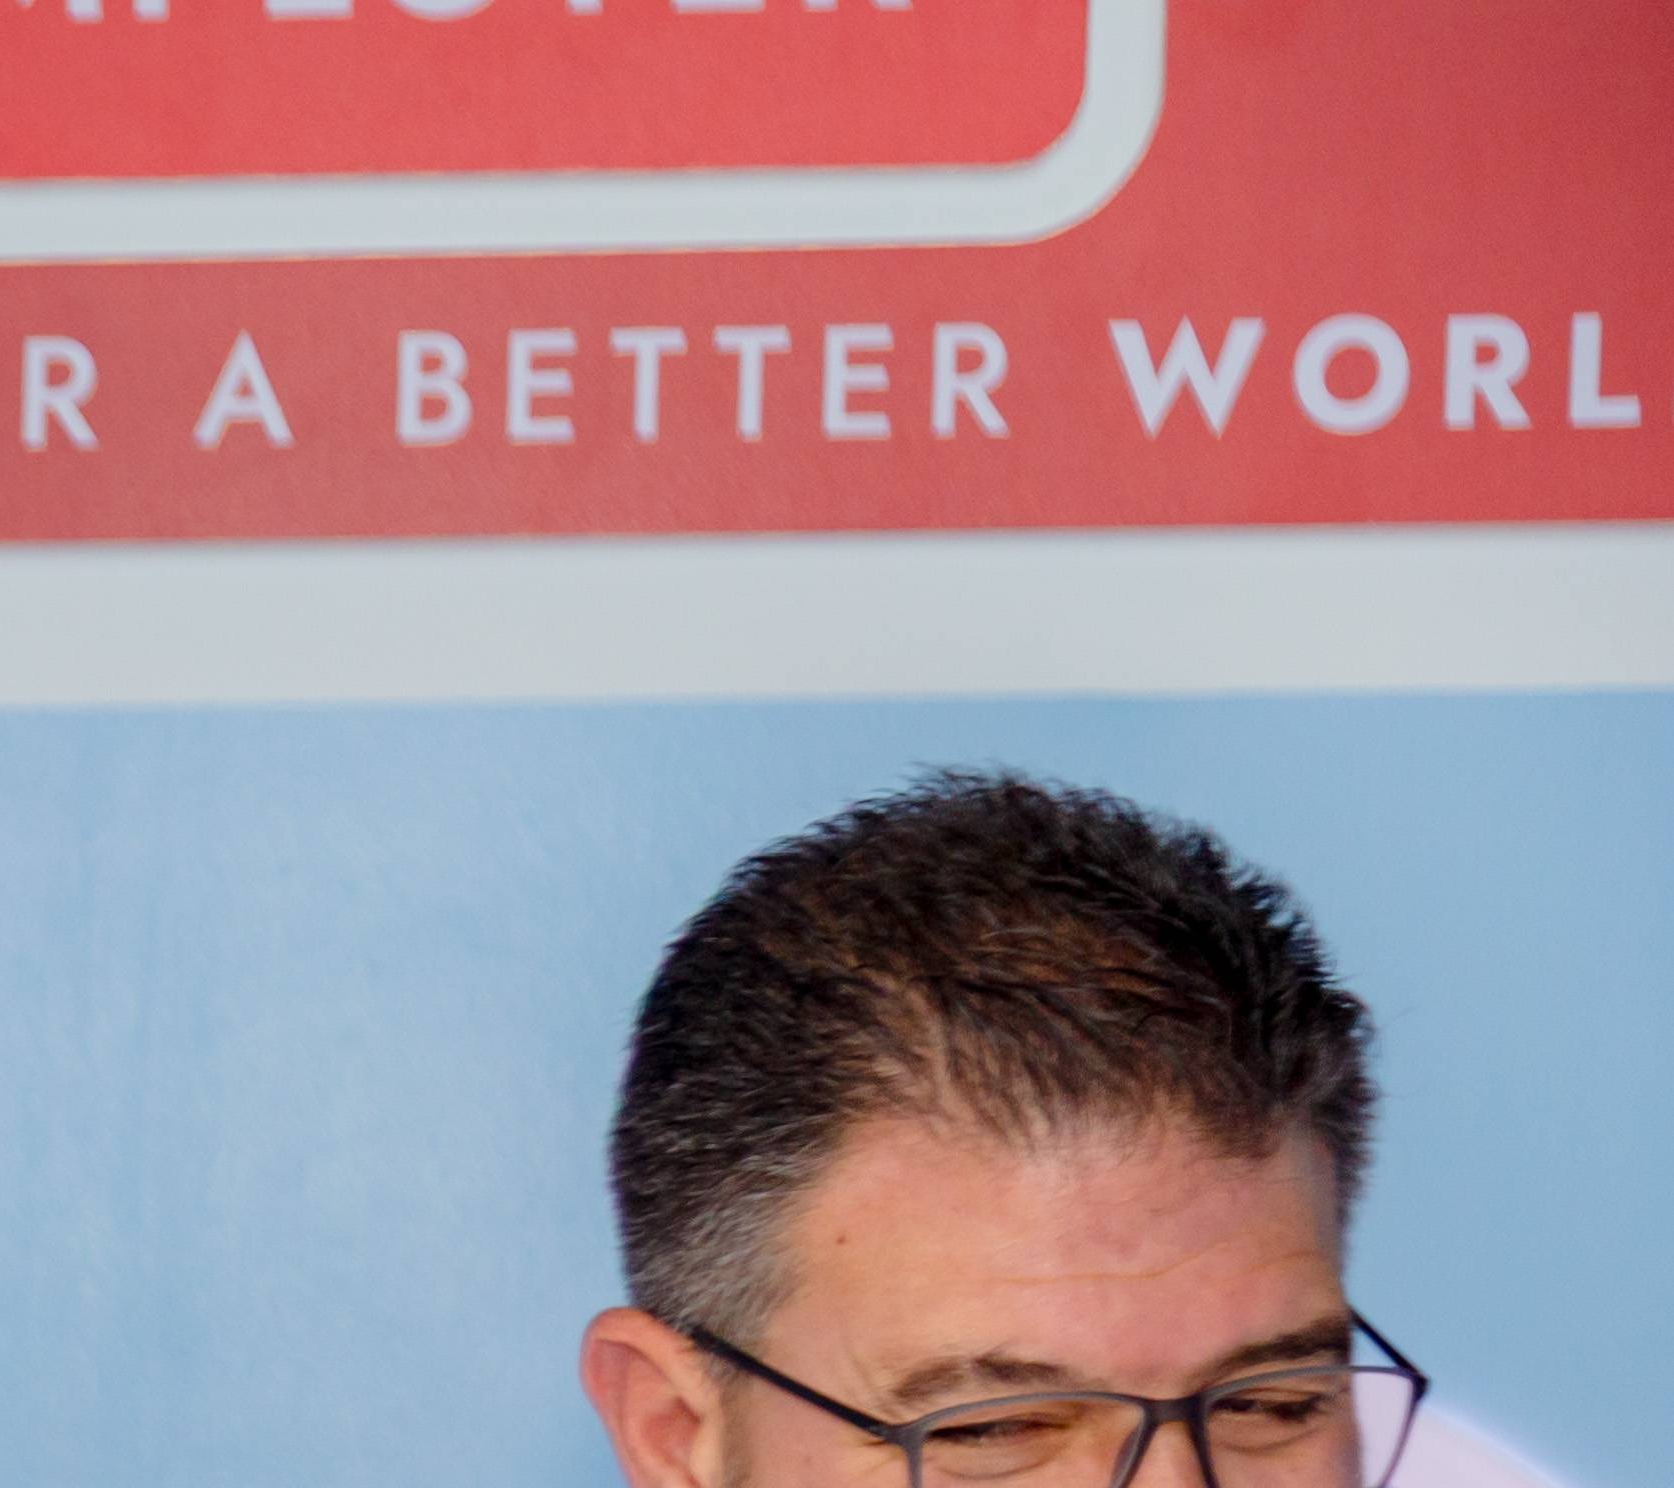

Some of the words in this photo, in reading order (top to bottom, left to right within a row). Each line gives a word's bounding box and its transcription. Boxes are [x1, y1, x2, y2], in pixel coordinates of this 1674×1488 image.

[193, 332, 294, 447] A
[393, 323, 1012, 447] BETTER
[1107, 310, 1674, 437] WORL
